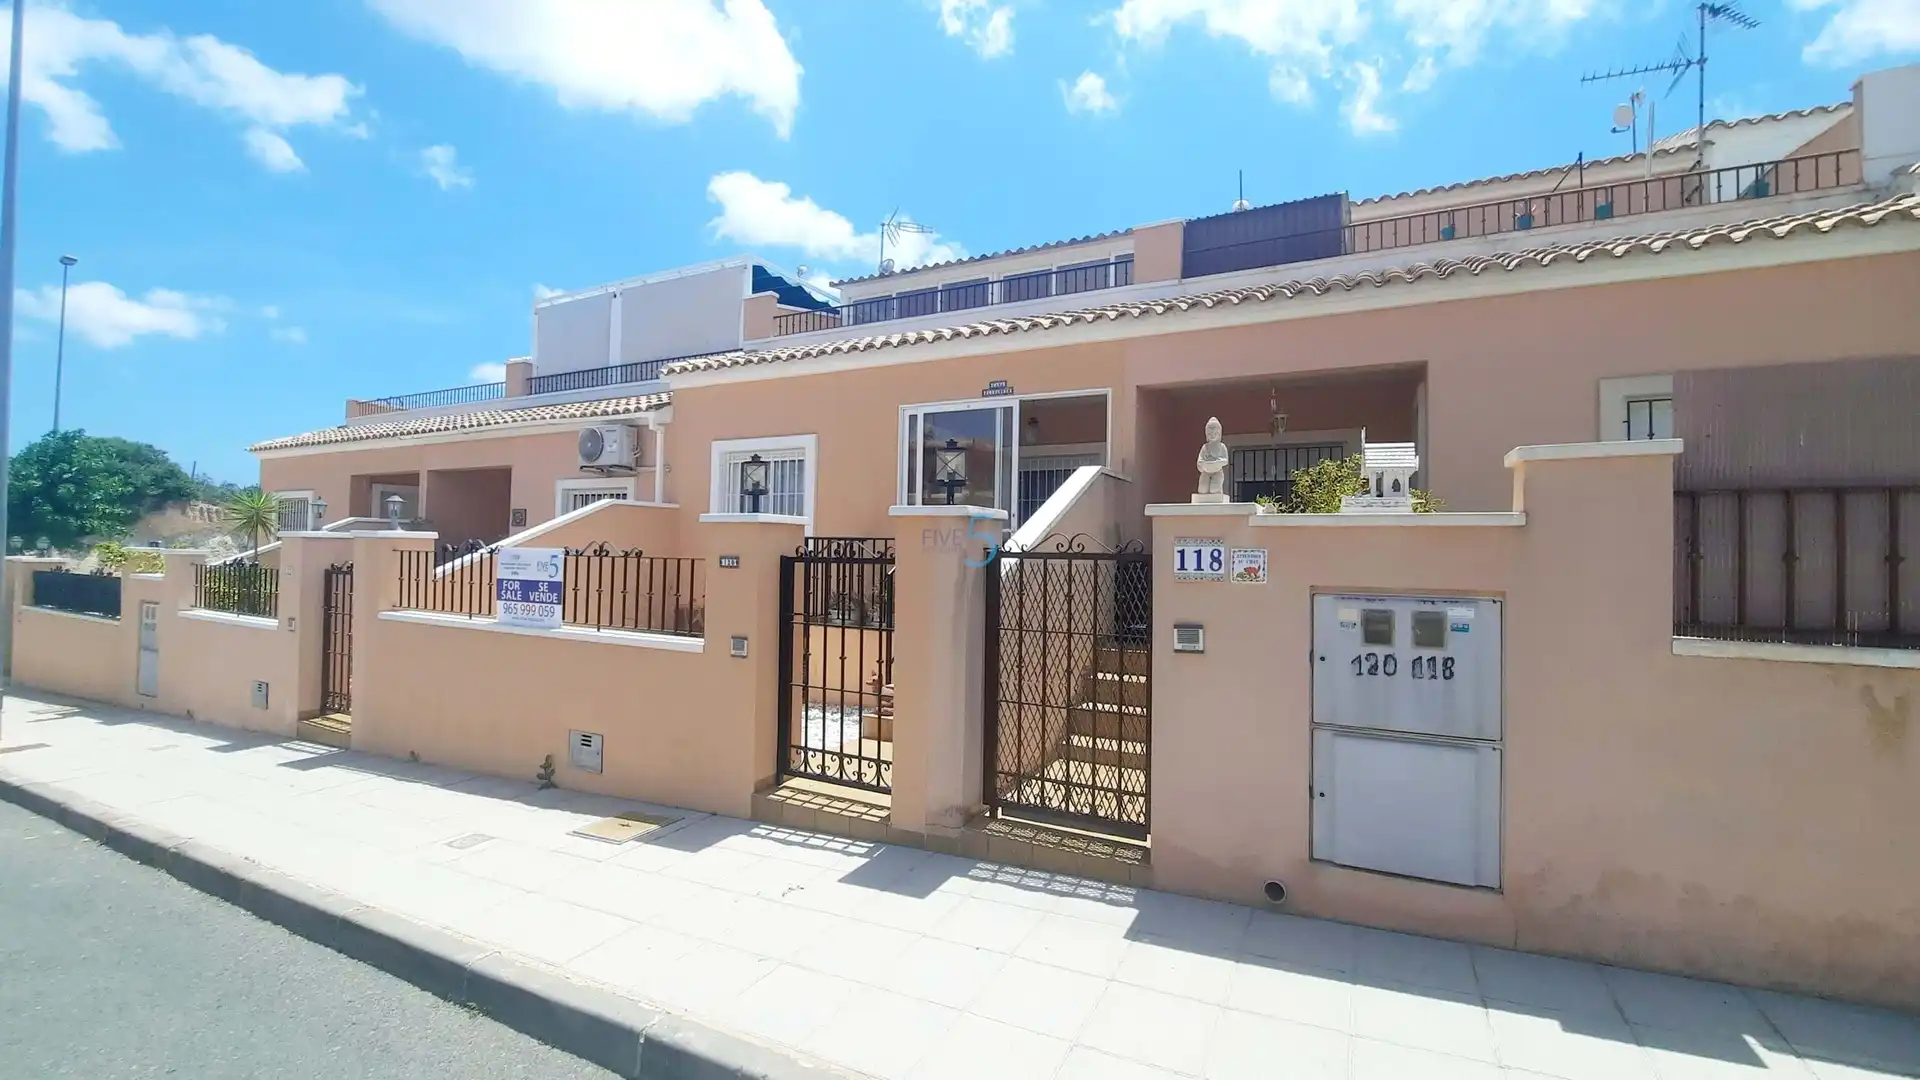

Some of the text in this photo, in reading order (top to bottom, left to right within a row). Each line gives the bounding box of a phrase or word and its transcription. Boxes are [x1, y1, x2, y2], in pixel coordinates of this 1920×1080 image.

[548, 554, 559, 578] 5
[1176, 548, 1223, 572] 118
[502, 580, 520, 591] FOR
[538, 582, 549, 593] SE
[501, 590, 522, 601] SALE
[529, 591, 559, 603] VENDE
[502, 602, 556, 618] 965 999 059
[1350, 652, 1456, 681] 120 118
